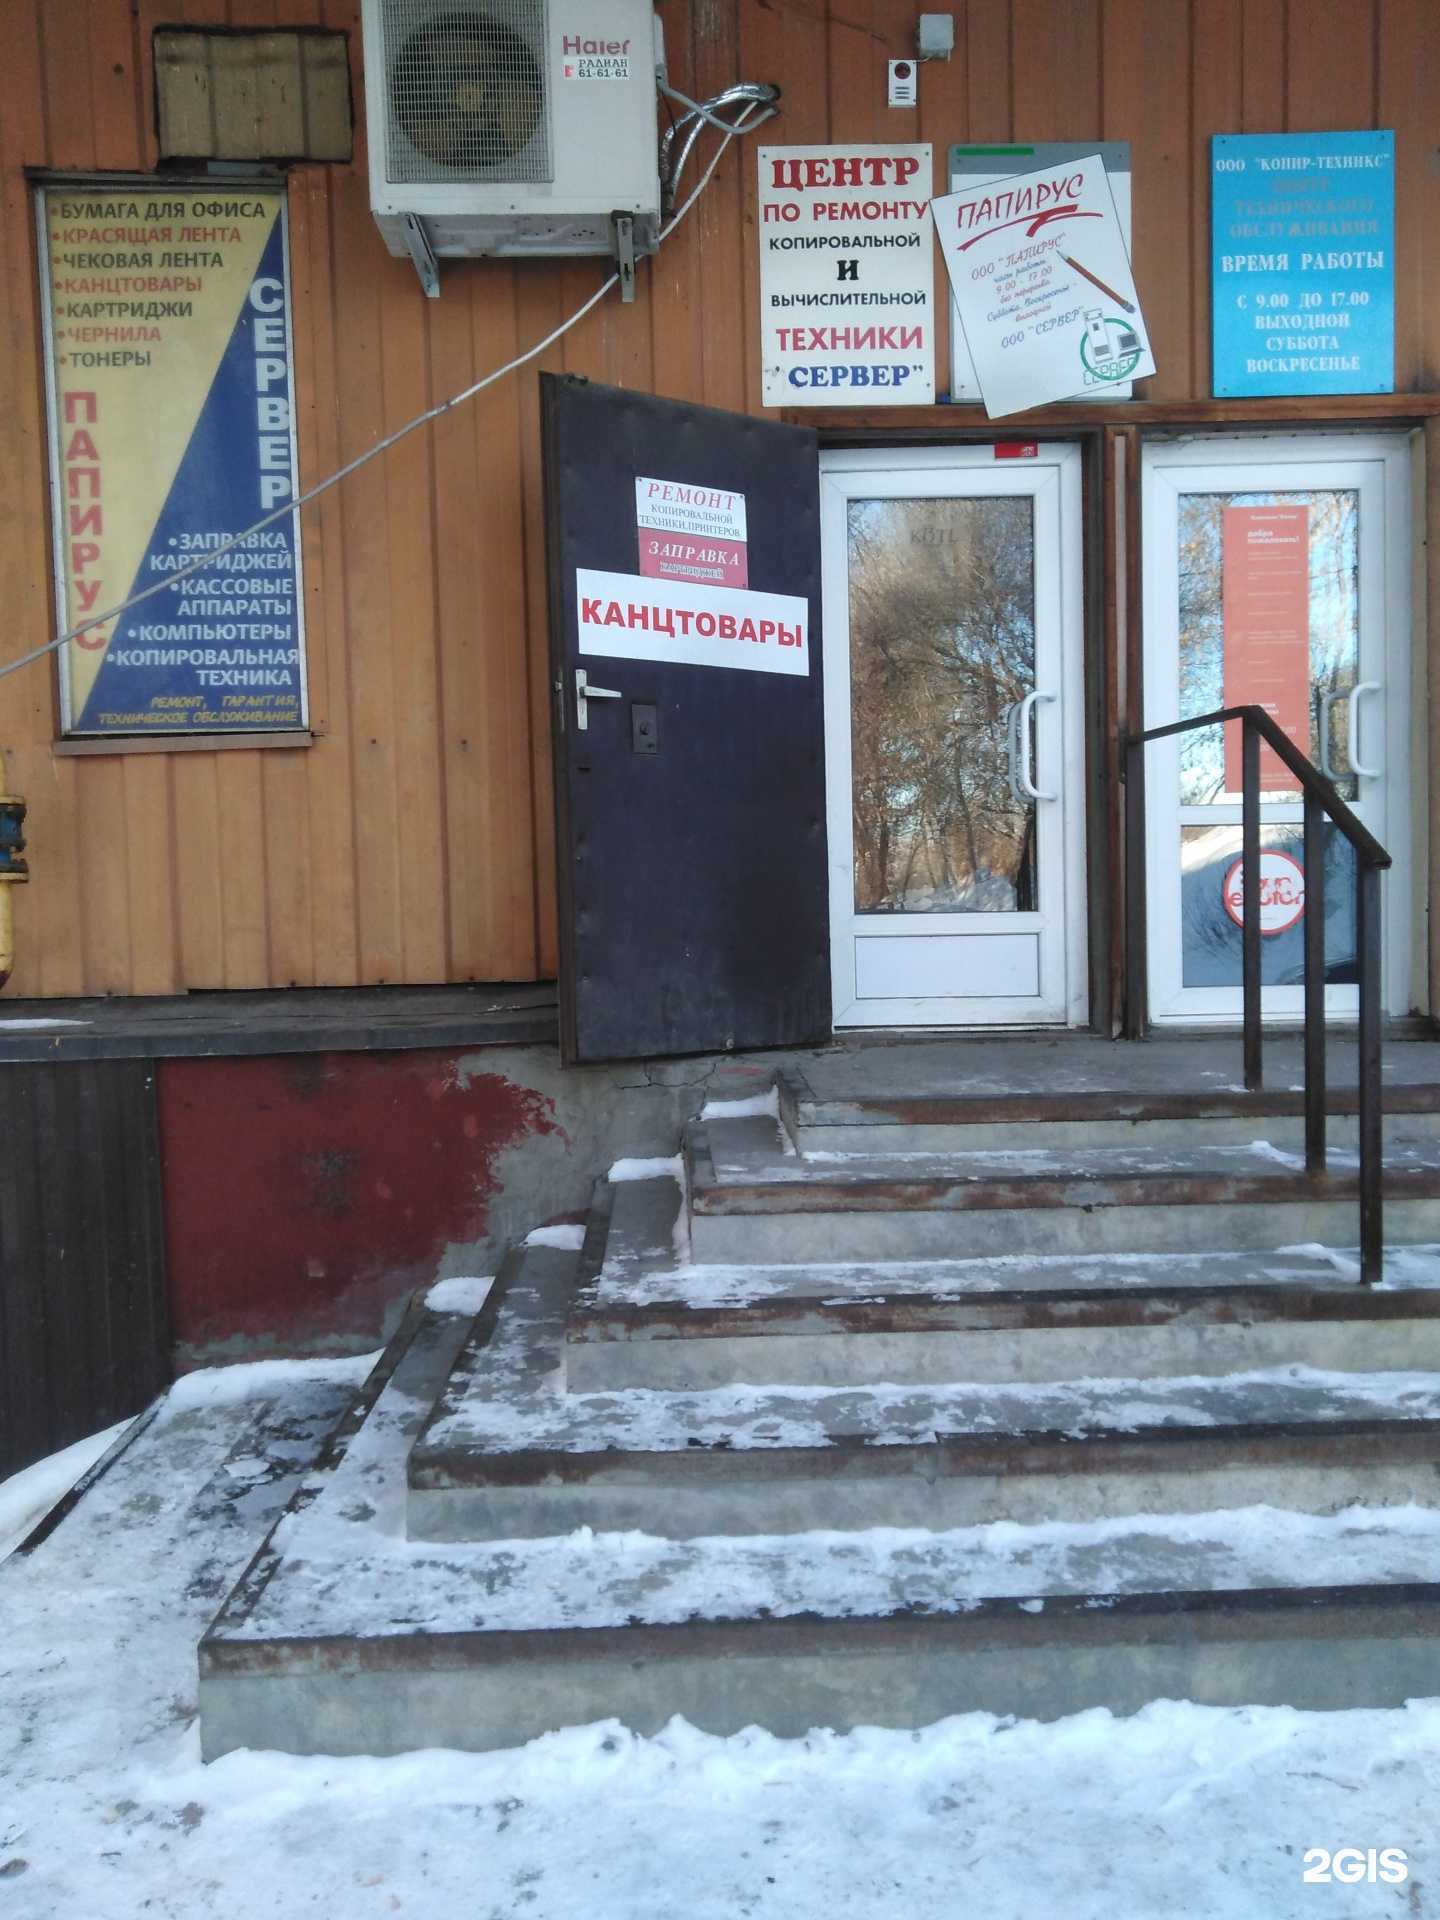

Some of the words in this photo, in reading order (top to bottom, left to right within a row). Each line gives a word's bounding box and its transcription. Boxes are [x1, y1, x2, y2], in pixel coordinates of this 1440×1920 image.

[563, 35, 631, 55] Haier
[579, 58, 628, 68] РАДИАН
[771, 157, 920, 191] ЦЕНТР
[1215, 159, 1246, 172] ООО
[60, 203, 139, 219] БУМАГА
[144, 202, 186, 221] ДЛЯ
[191, 201, 266, 218] ОФИСА
[763, 203, 801, 222] ПО
[813, 200, 930, 221] РЕМОНТУ
[956, 173, 1085, 231] ПАПИРУС
[63, 227, 172, 244] КРАСЯЩАЯ
[178, 227, 242, 243] ЛЕНТА
[770, 232, 921, 250] КОПИРОВАЛЬНОЙ
[63, 252, 153, 268] ЧЕКОВАЯ
[158, 252, 224, 268] ЛЕНТА
[1221, 253, 1289, 273] ВРЕМЯ
[1301, 251, 1384, 270] РАБОТЫ
[836, 259, 860, 281] И
[971, 262, 995, 281] ООО
[64, 277, 202, 295] КАНЦТОВАРЫ
[771, 290, 927, 307] ВЫЧИСЛИТЕЛЬНОЙ
[1236, 294, 1247, 309] С
[1256, 293, 1289, 308] 9.00
[1298, 292, 1322, 310] ДО
[1331, 291, 1370, 307] 17.00
[67, 302, 193, 320] КАРТРИДЖИ
[1255, 312, 1350, 332] ВЫХОДНОЙ
[67, 327, 161, 343] ЧЕРНИЛА
[775, 326, 923, 351] ТЕХНИКИ
[1001, 330, 1025, 348] ООО
[1266, 335, 1340, 351] СУББОТА
[69, 351, 151, 368] ТОНЕРЫ
[1246, 356, 1361, 373] ВОСКРЕСЕНЬЕ
[249, 277, 291, 510] СЕРВЕР
[648, 483, 736, 511] РЕМОНТ
[63, 391, 107, 651] ПАПИРУС
[650, 504, 733, 525] КОПИРОВАЛЬНОЙ
[178, 533, 287, 550] ЗАПРАВКА
[648, 541, 740, 566] ЗАПРАВКА
[181, 578, 293, 595] КАССОВЫЕ
[177, 599, 292, 616] АППАРАТЫ
[582, 598, 802, 648] КАНЦТОВАРЫ
[139, 624, 292, 641] КОМПЬЮТЕРЫ
[116, 649, 299, 666] КОПИРОВАЛЬНАЯ
[196, 670, 292, 686] ТЕХНИКА
